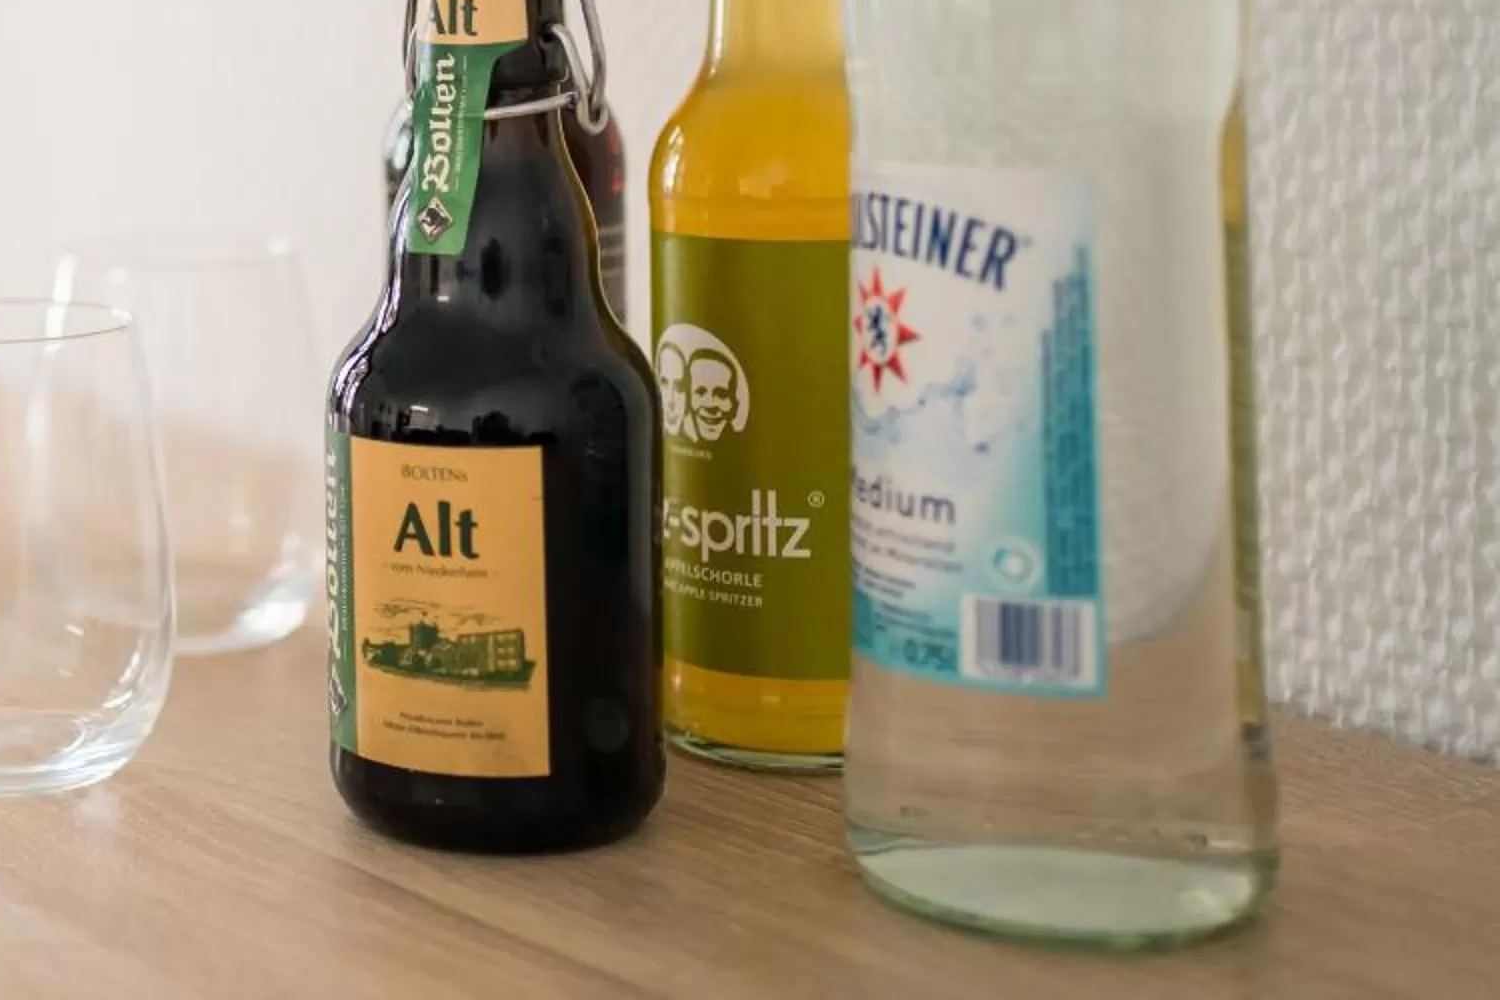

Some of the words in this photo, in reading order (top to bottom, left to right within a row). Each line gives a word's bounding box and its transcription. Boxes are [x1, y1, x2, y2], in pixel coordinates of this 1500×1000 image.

[421, 52, 456, 193] Bolten
[851, 465, 956, 525] edium
[393, 500, 480, 559] Alt
